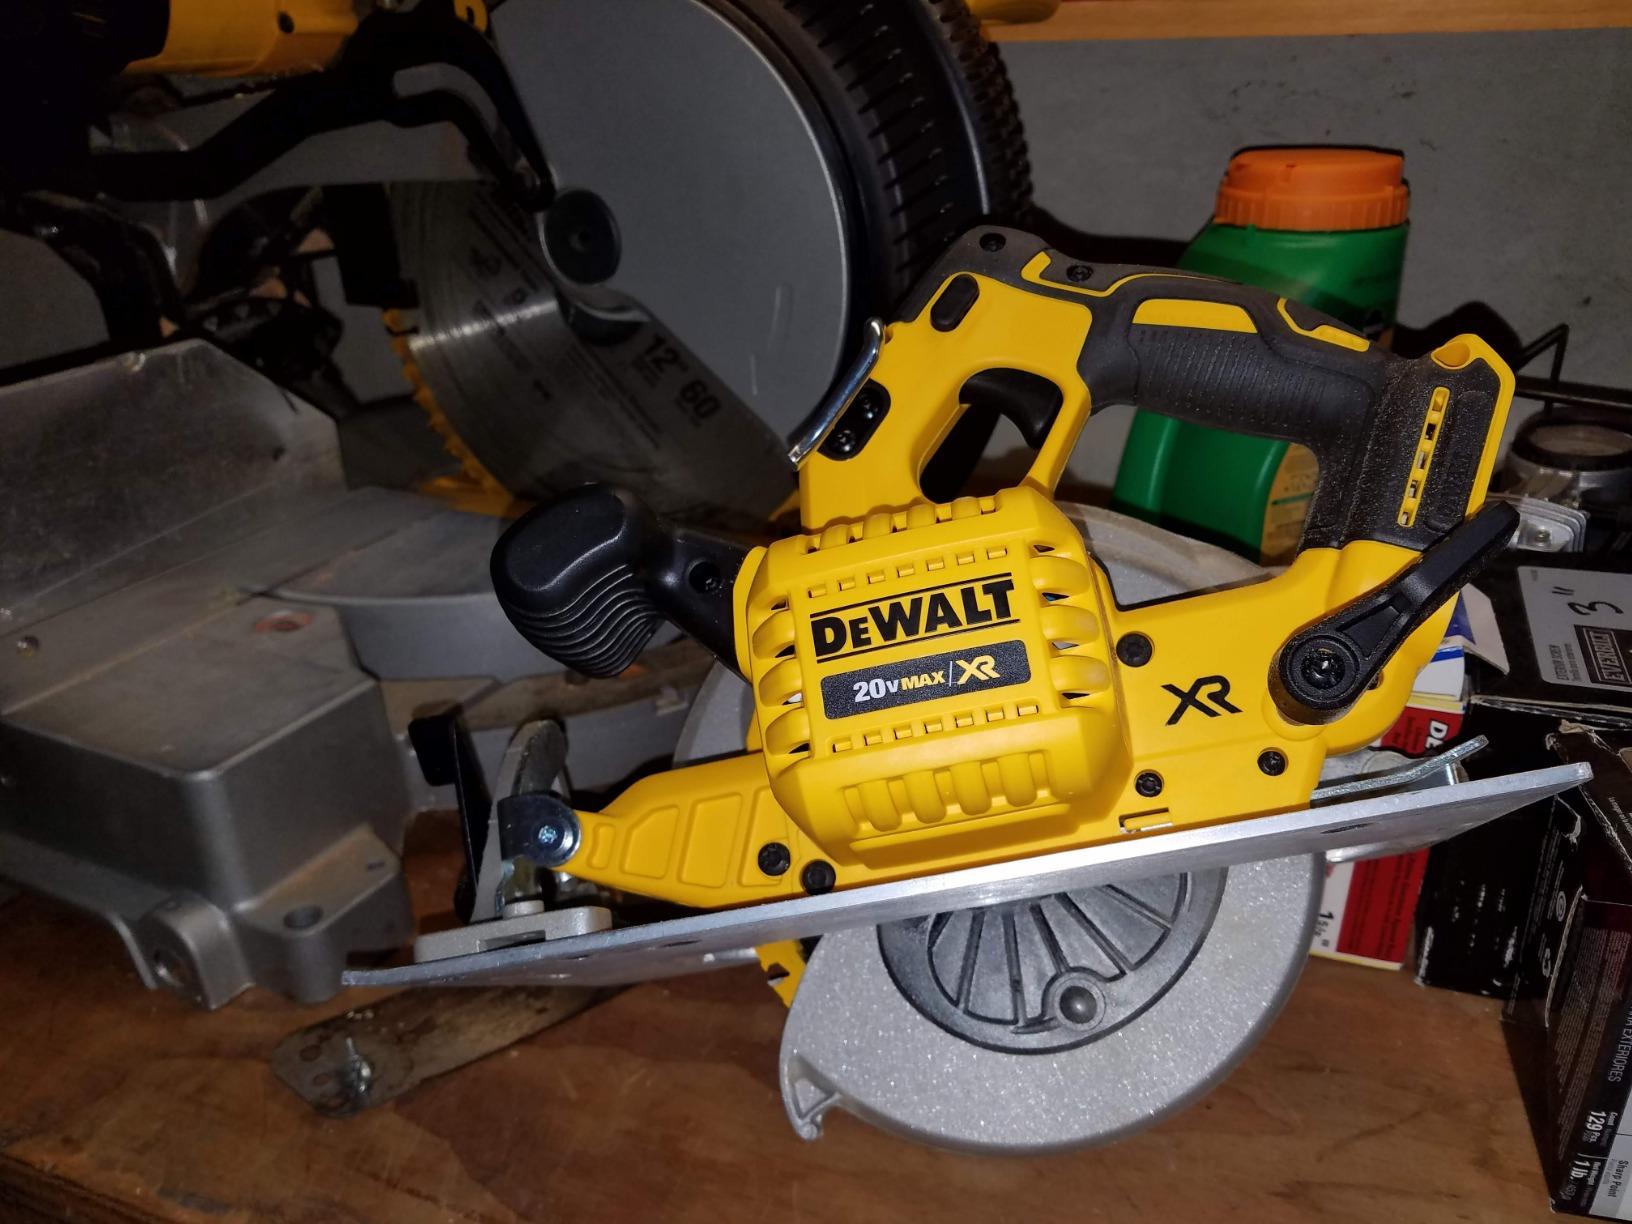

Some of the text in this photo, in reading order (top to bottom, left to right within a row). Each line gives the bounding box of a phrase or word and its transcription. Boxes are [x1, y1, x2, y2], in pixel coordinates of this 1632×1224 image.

[900, 670, 946, 691] MAX
[955, 654, 1001, 685] XR
[1161, 674, 1244, 726] XR
[1586, 1111, 1608, 1132] 129
[1612, 1160, 1629, 1180] Sharp
